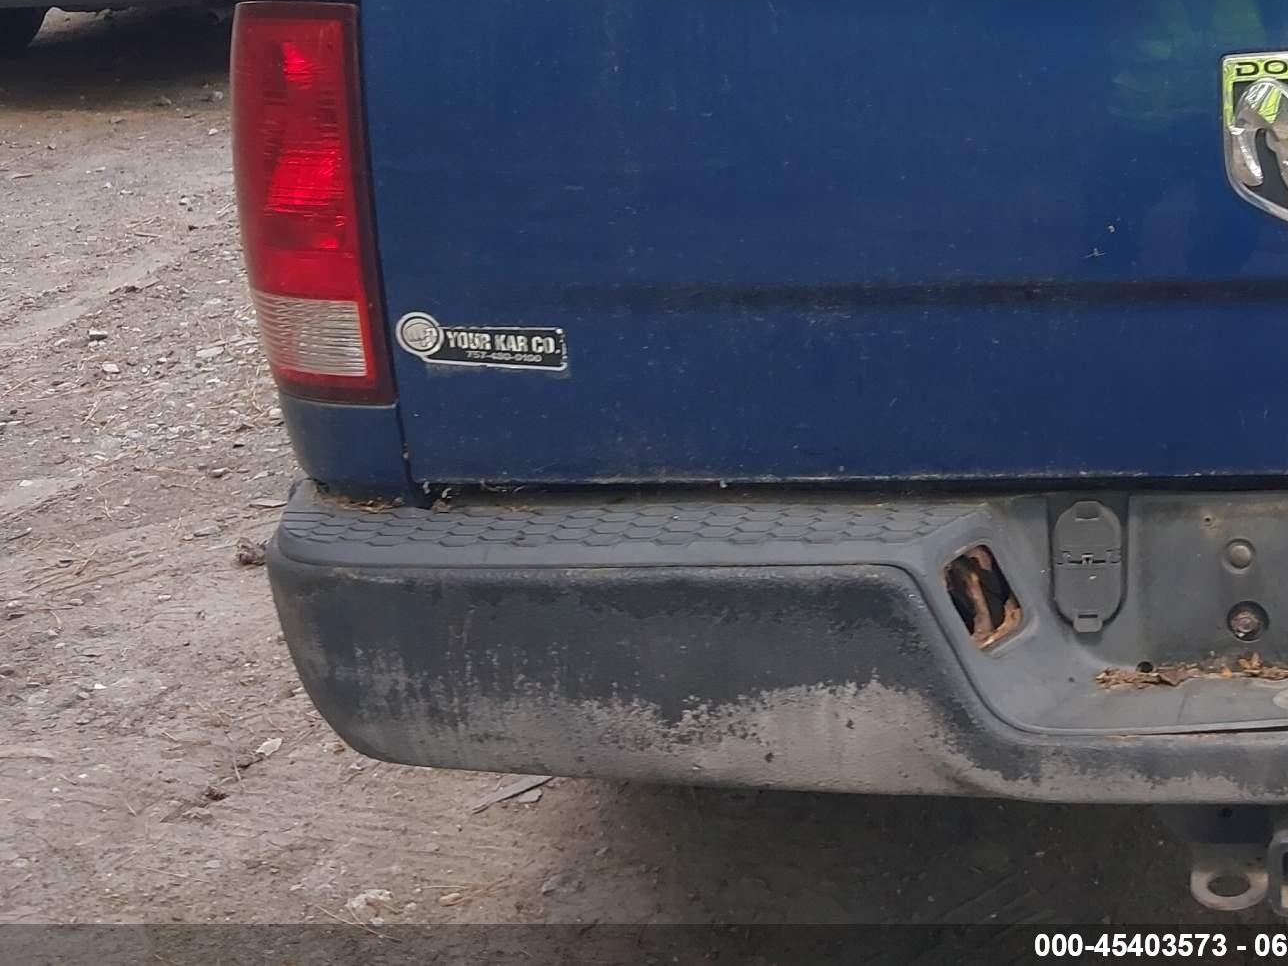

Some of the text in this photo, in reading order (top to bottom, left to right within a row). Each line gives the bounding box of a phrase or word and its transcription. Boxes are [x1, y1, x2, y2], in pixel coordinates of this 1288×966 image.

[447, 331, 561, 354] YOUR KAR CO.
